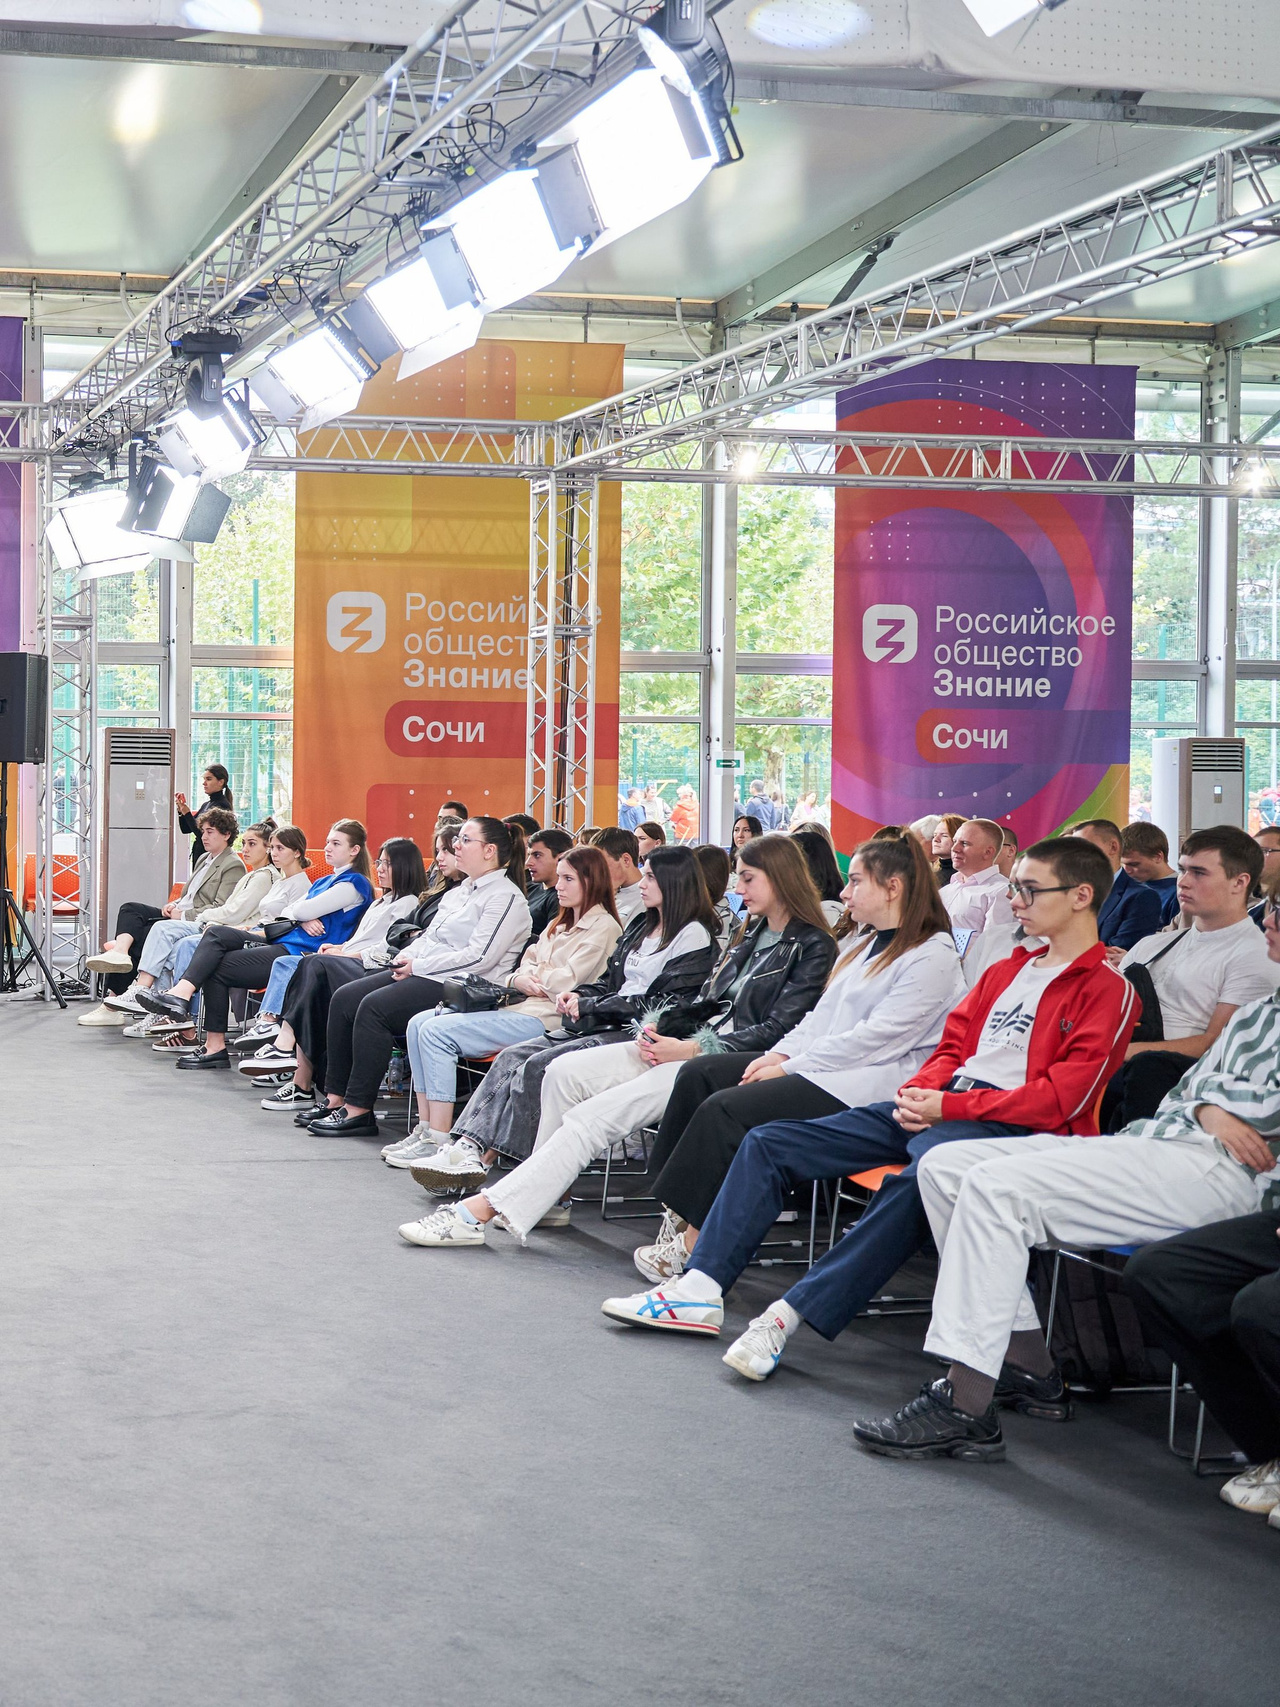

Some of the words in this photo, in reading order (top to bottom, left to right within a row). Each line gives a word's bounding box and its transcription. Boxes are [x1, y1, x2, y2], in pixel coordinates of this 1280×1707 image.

[405, 592, 602, 626] Российке
[936, 605, 1116, 636] Российское
[934, 637, 1083, 670] общество
[403, 658, 528, 689] Знание
[933, 669, 1051, 698] Знание
[402, 715, 485, 743] Сочи
[932, 723, 1008, 749] Сочи
